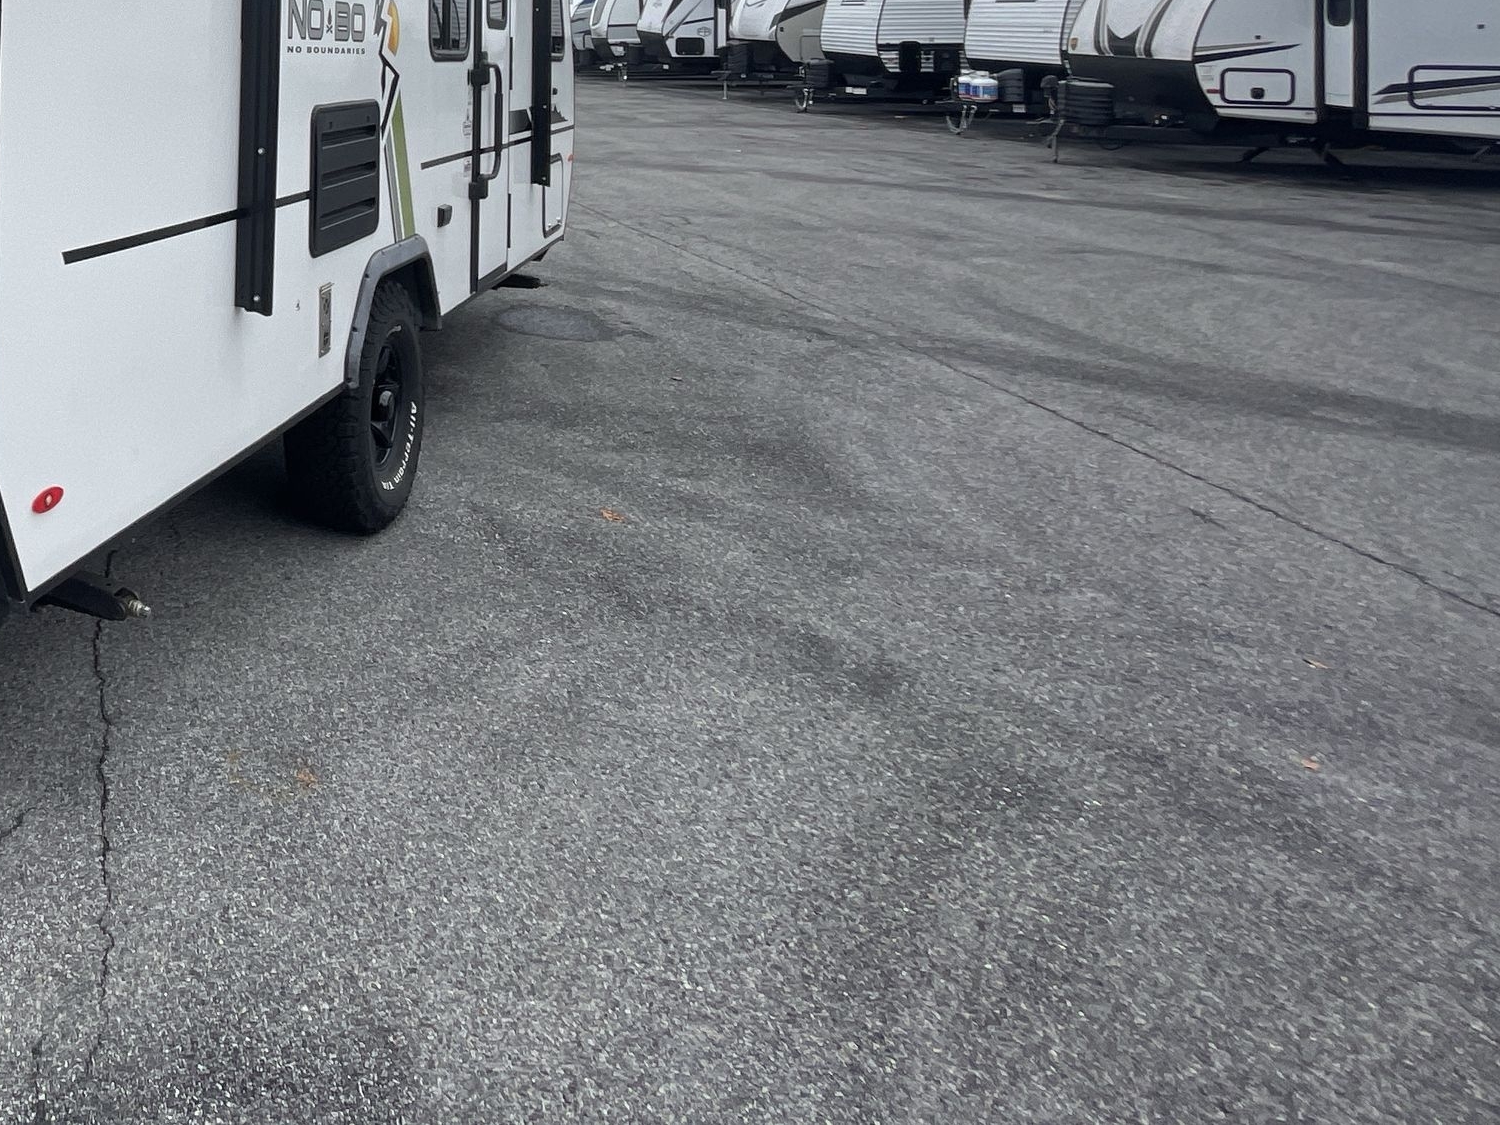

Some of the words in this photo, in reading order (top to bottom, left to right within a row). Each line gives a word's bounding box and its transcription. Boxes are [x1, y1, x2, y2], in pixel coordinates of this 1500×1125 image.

[334, 0, 366, 43] BO
[286, 45, 302, 54] NO
[306, 46, 366, 55] BOUNDARIES
